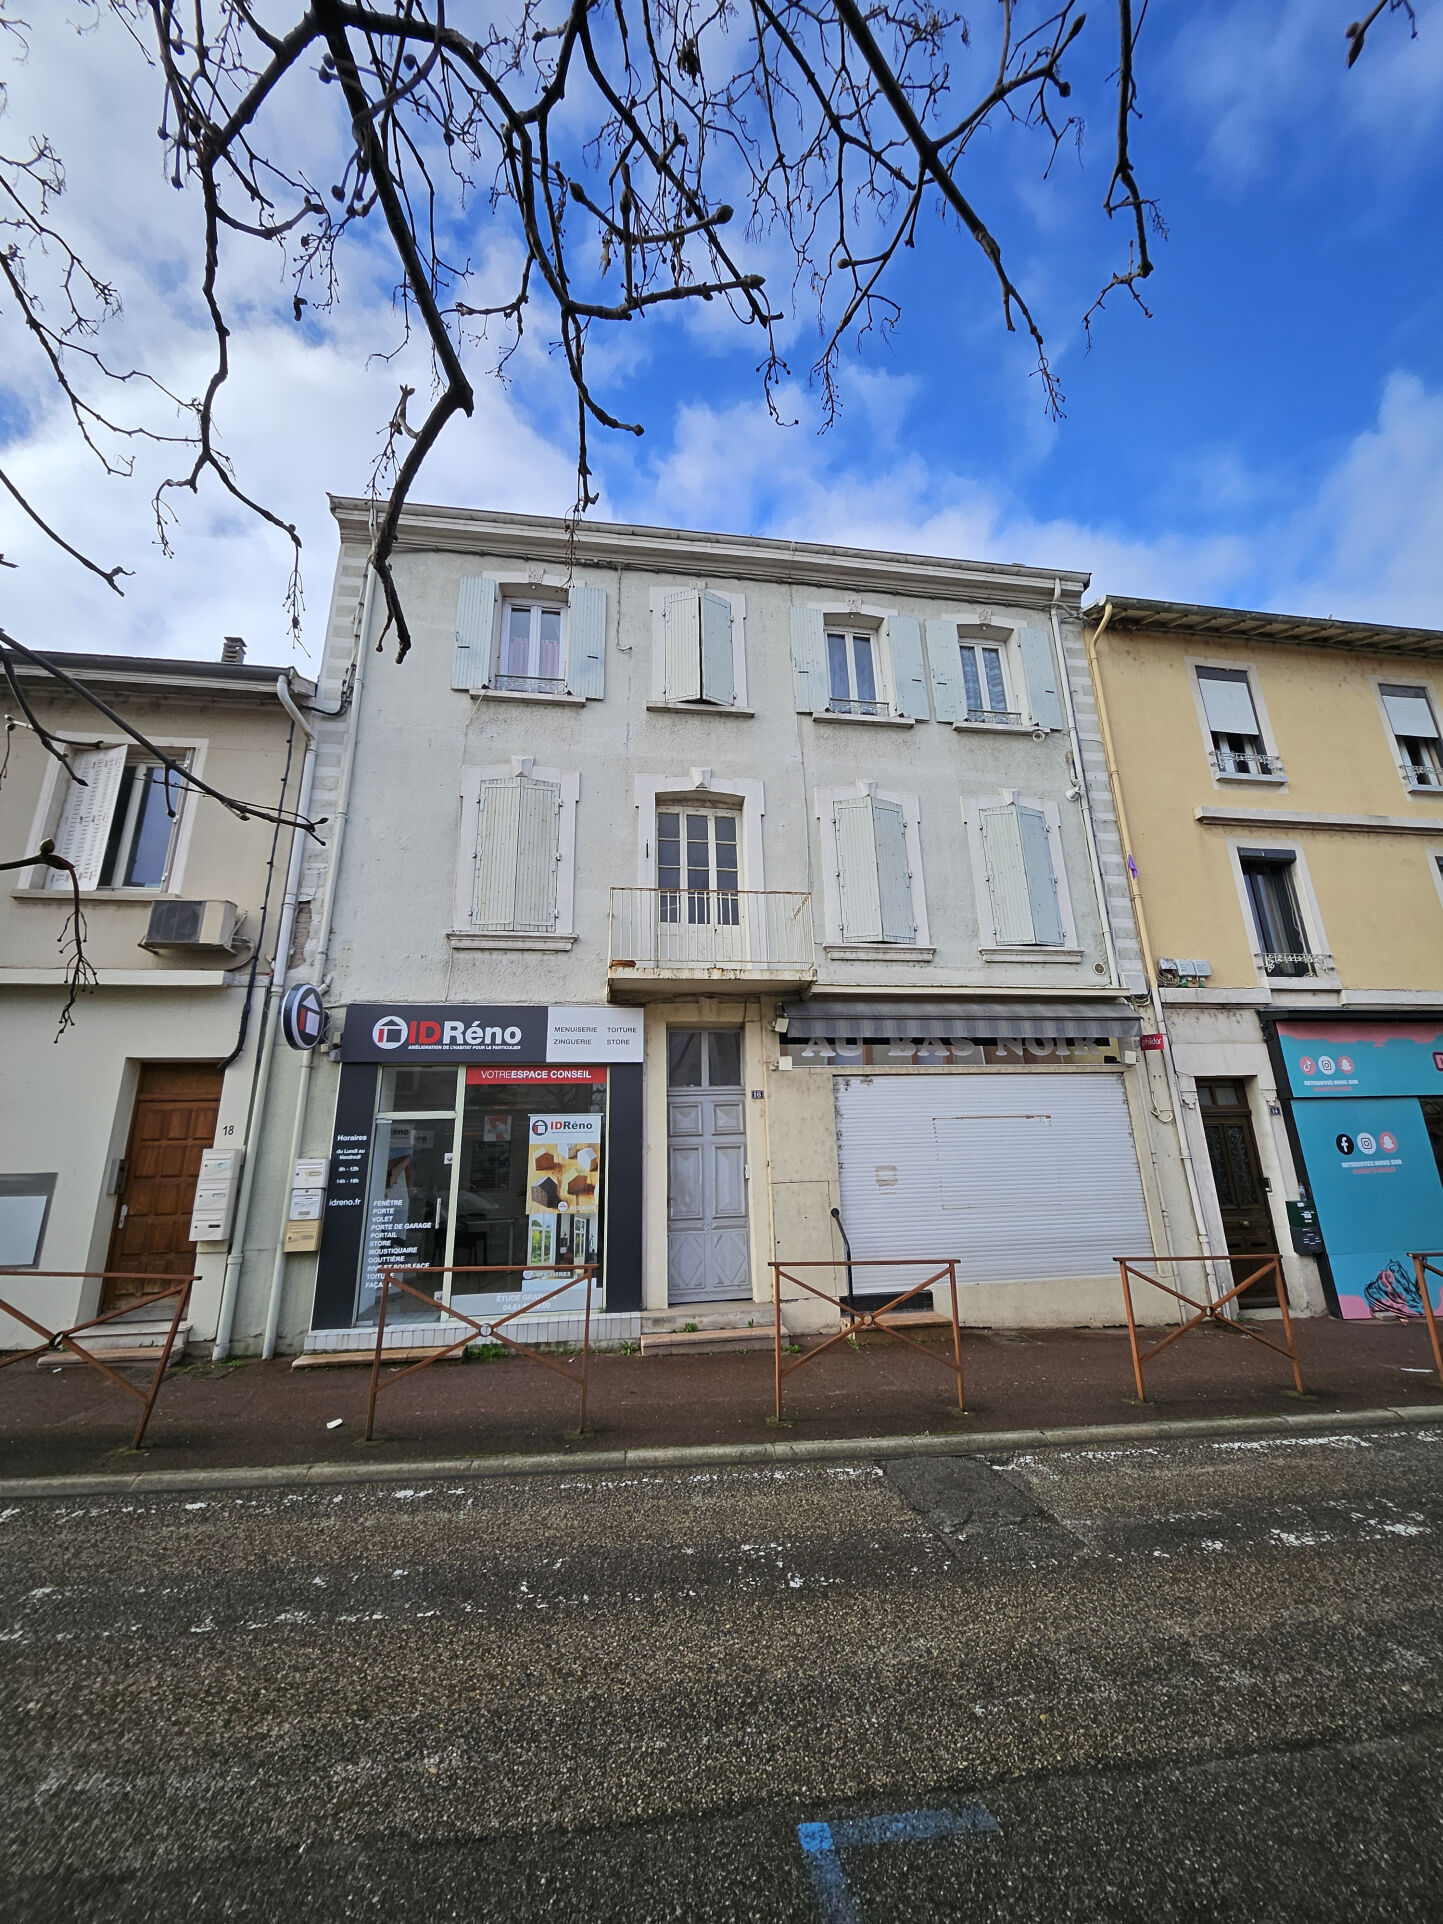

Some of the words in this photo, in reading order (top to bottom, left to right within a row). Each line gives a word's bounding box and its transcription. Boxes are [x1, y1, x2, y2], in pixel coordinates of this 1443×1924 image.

[408, 1020, 522, 1044] IDRéno
[801, 1036, 865, 1057] AU
[550, 1070, 591, 1079] CONSEIL
[550, 1121, 593, 1130] IDRéno
[222, 1125, 235, 1136] 18
[329, 1198, 361, 1206] idreno.fr
[368, 1247, 418, 1255] MOUSTIQUAIRE
